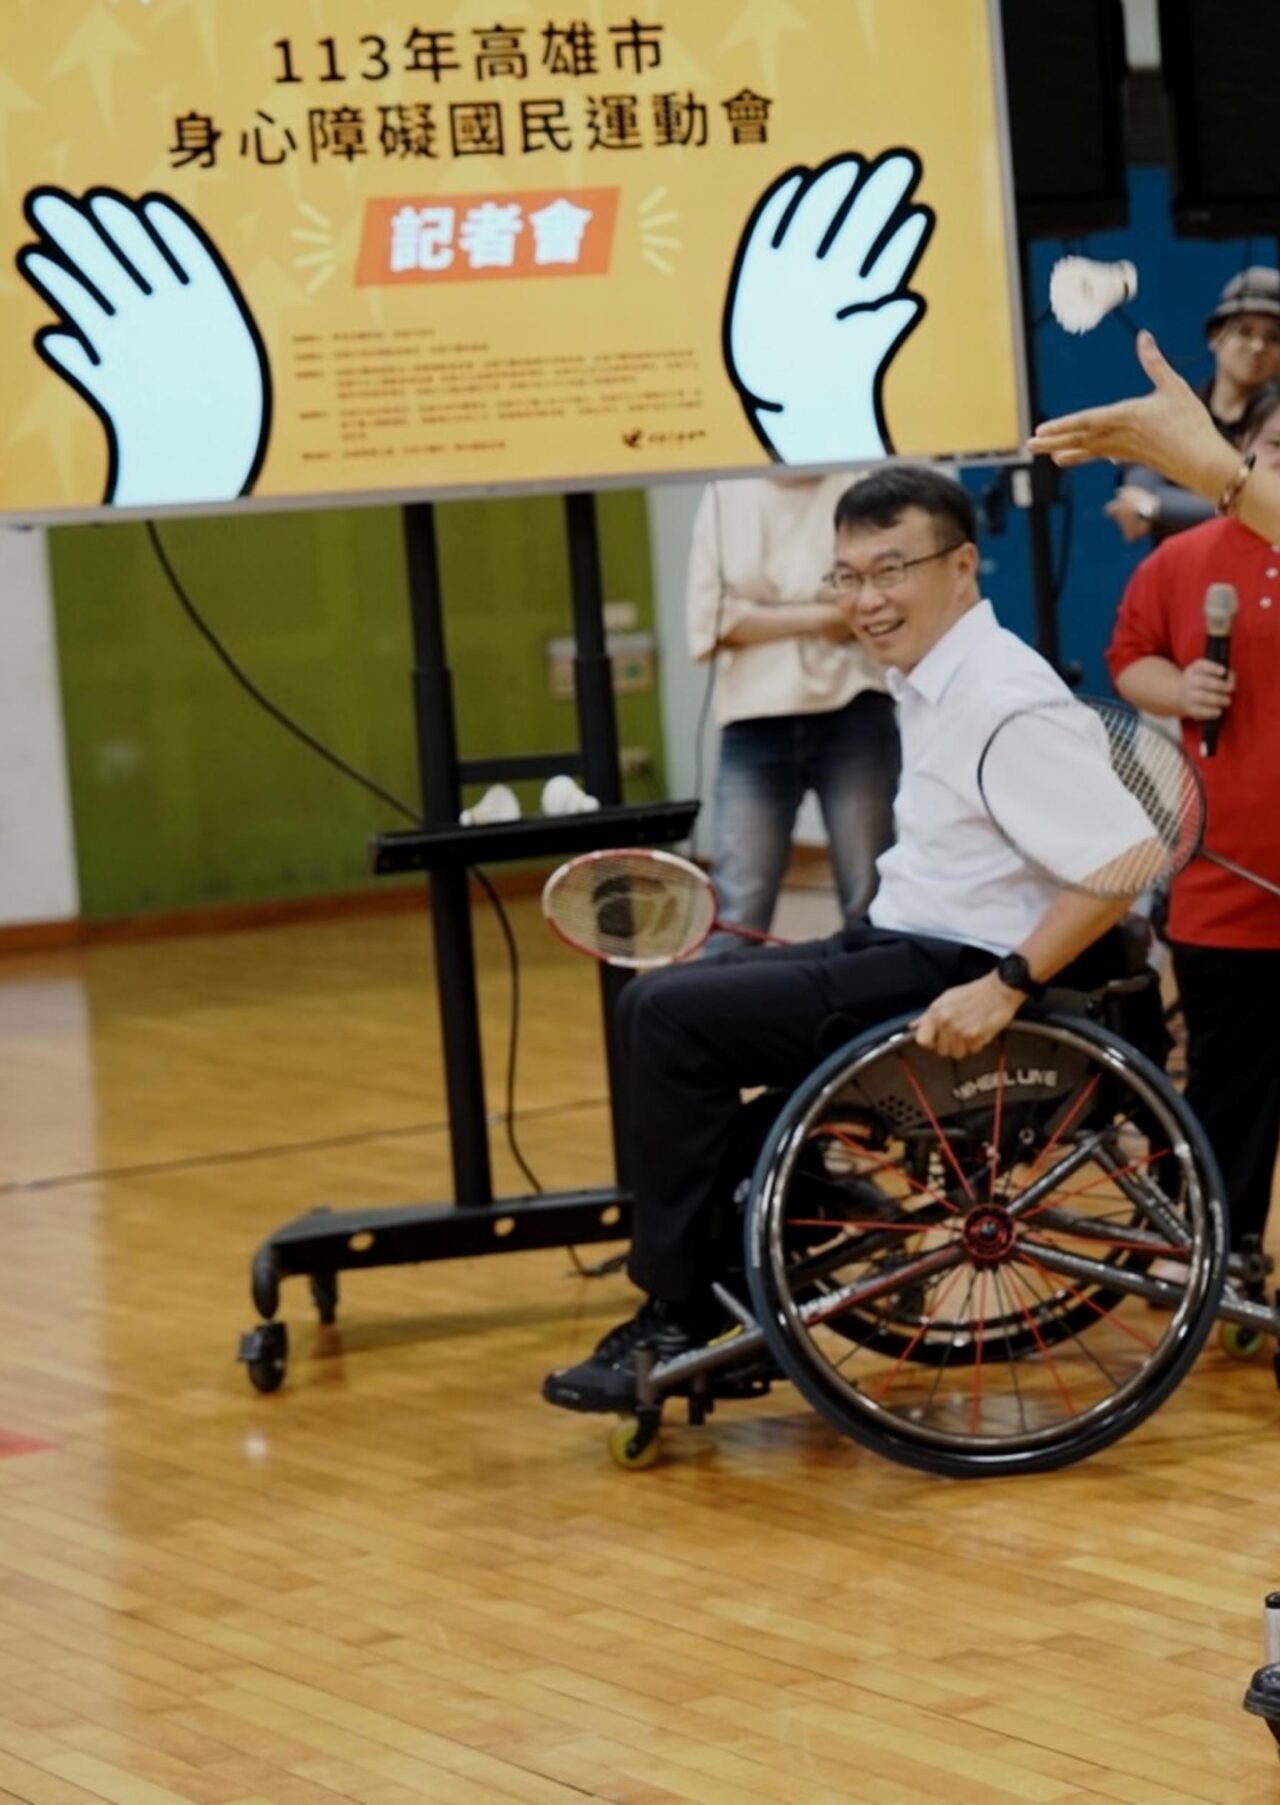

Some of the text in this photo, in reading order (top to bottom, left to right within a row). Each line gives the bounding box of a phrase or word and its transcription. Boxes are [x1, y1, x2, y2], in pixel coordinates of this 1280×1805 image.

[273, 18, 664, 85] 113年高雄市
[167, 87, 775, 169] 身心障礙國民運動會
[388, 198, 592, 271] 記者會
